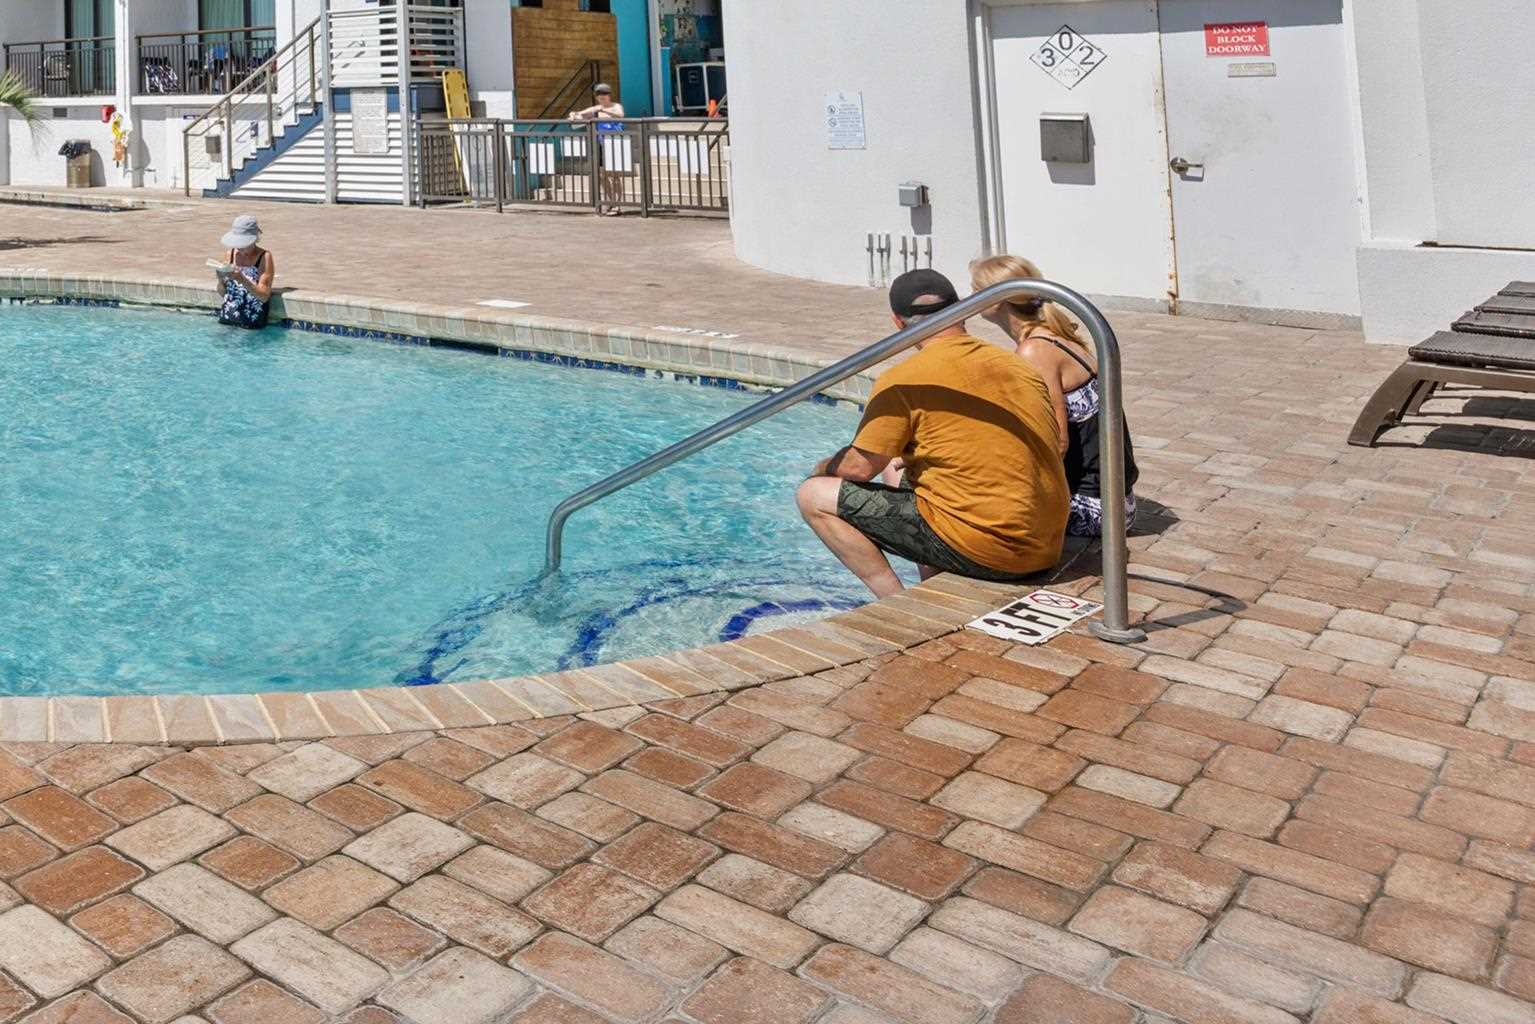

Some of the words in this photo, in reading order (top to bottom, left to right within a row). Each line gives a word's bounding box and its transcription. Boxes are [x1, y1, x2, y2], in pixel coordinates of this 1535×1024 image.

[1212, 26, 1229, 34] DO
[1233, 25, 1257, 33] NOT
[1058, 31, 1073, 50] 0
[1208, 44, 1265, 54] DOORWAY
[1217, 35, 1256, 44] BLOCK
[1041, 47, 1056, 67] 3
[1079, 45, 1095, 65] 2
[999, 602, 1072, 629] FT
[982, 618, 1042, 637] 3
